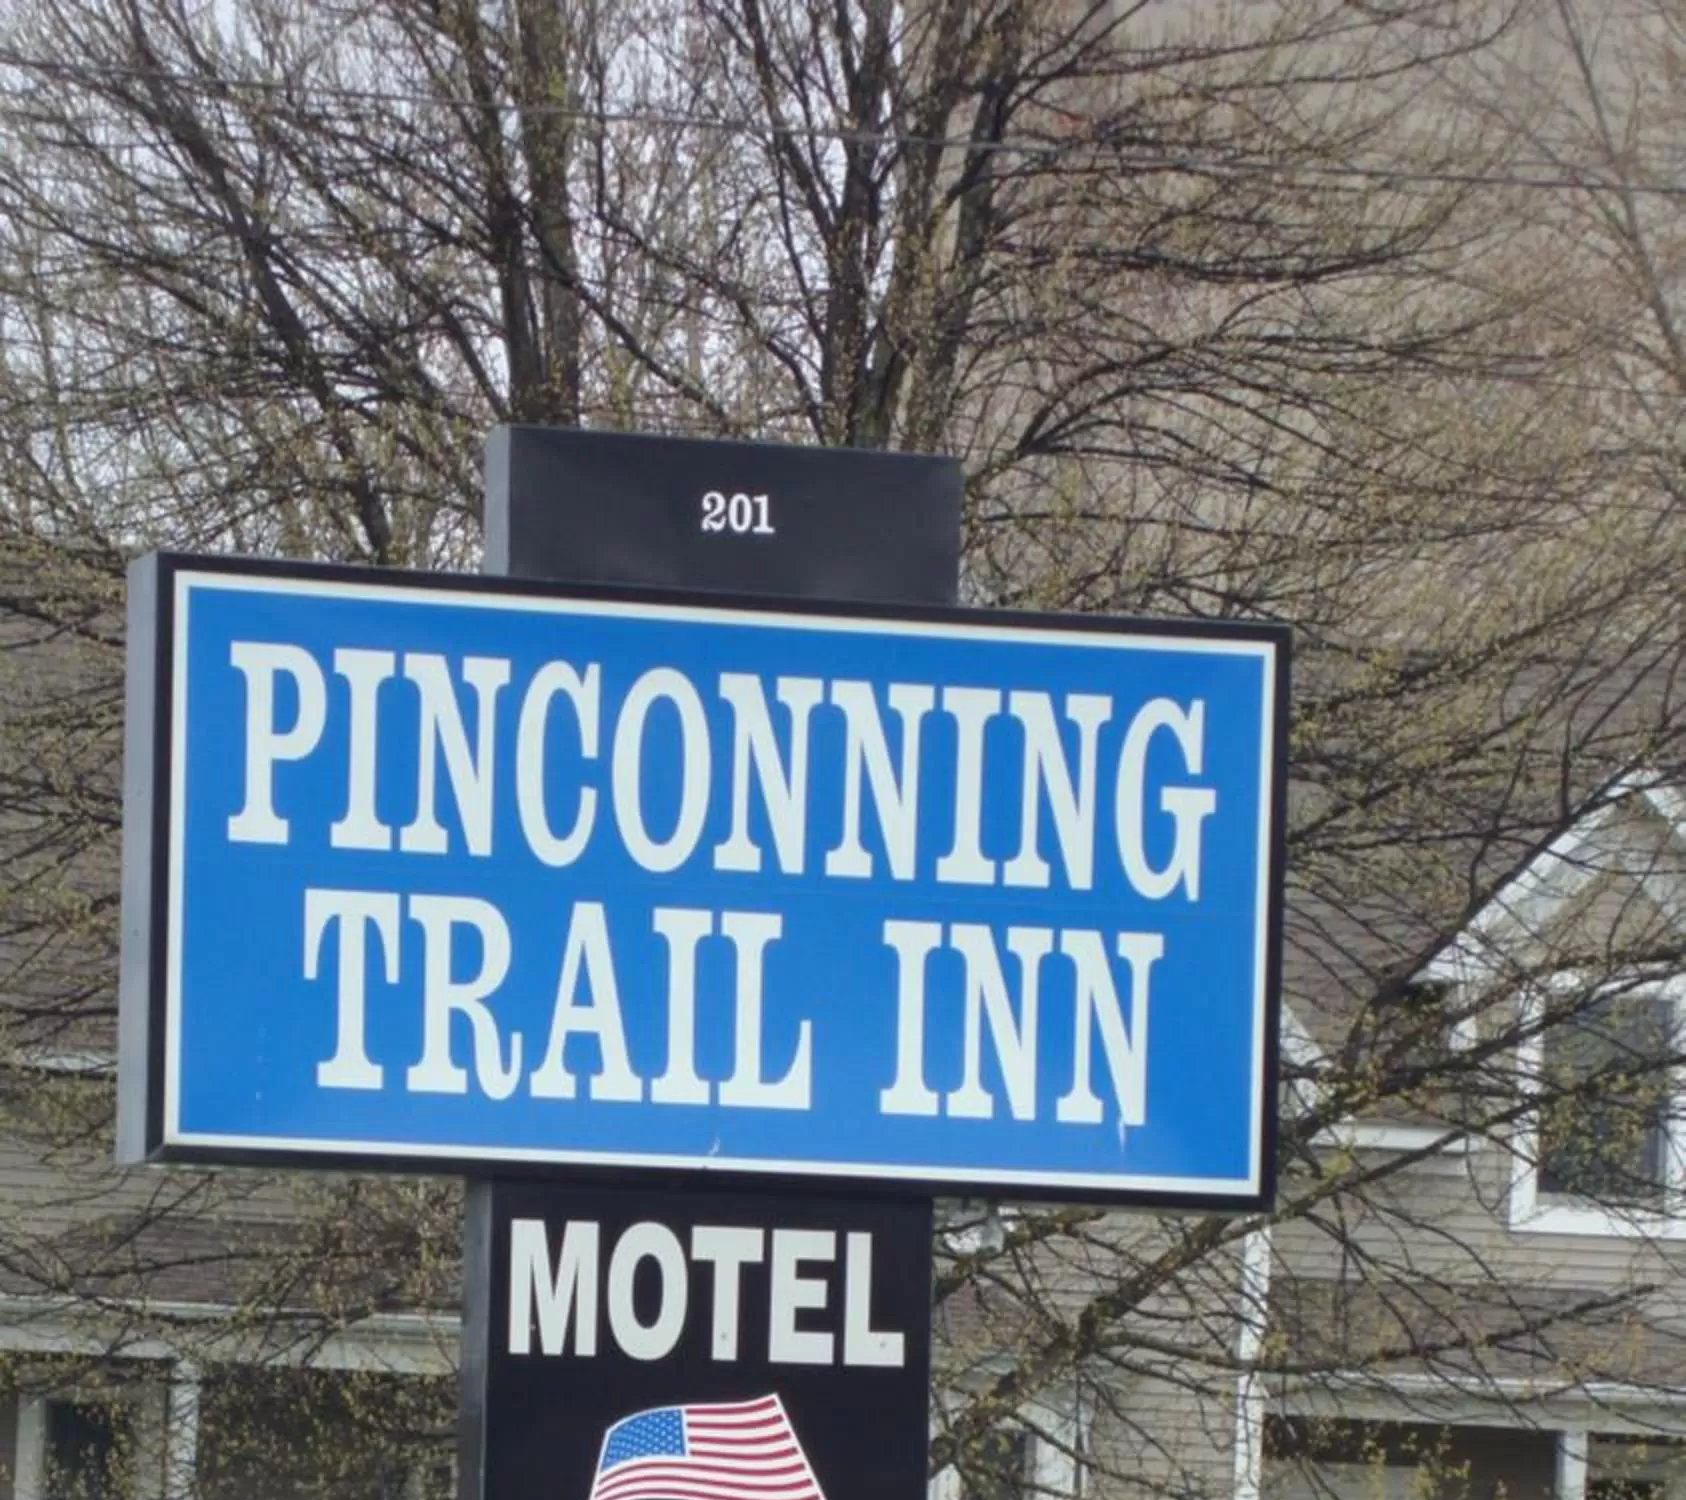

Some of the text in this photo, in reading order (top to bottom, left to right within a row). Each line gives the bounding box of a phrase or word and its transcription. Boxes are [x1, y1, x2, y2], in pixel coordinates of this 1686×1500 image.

[701, 491, 775, 534] 201
[228, 641, 1217, 901] PINCONNING
[303, 888, 1164, 1126] TRAIL INN
[508, 1218, 905, 1367] MOTEL
